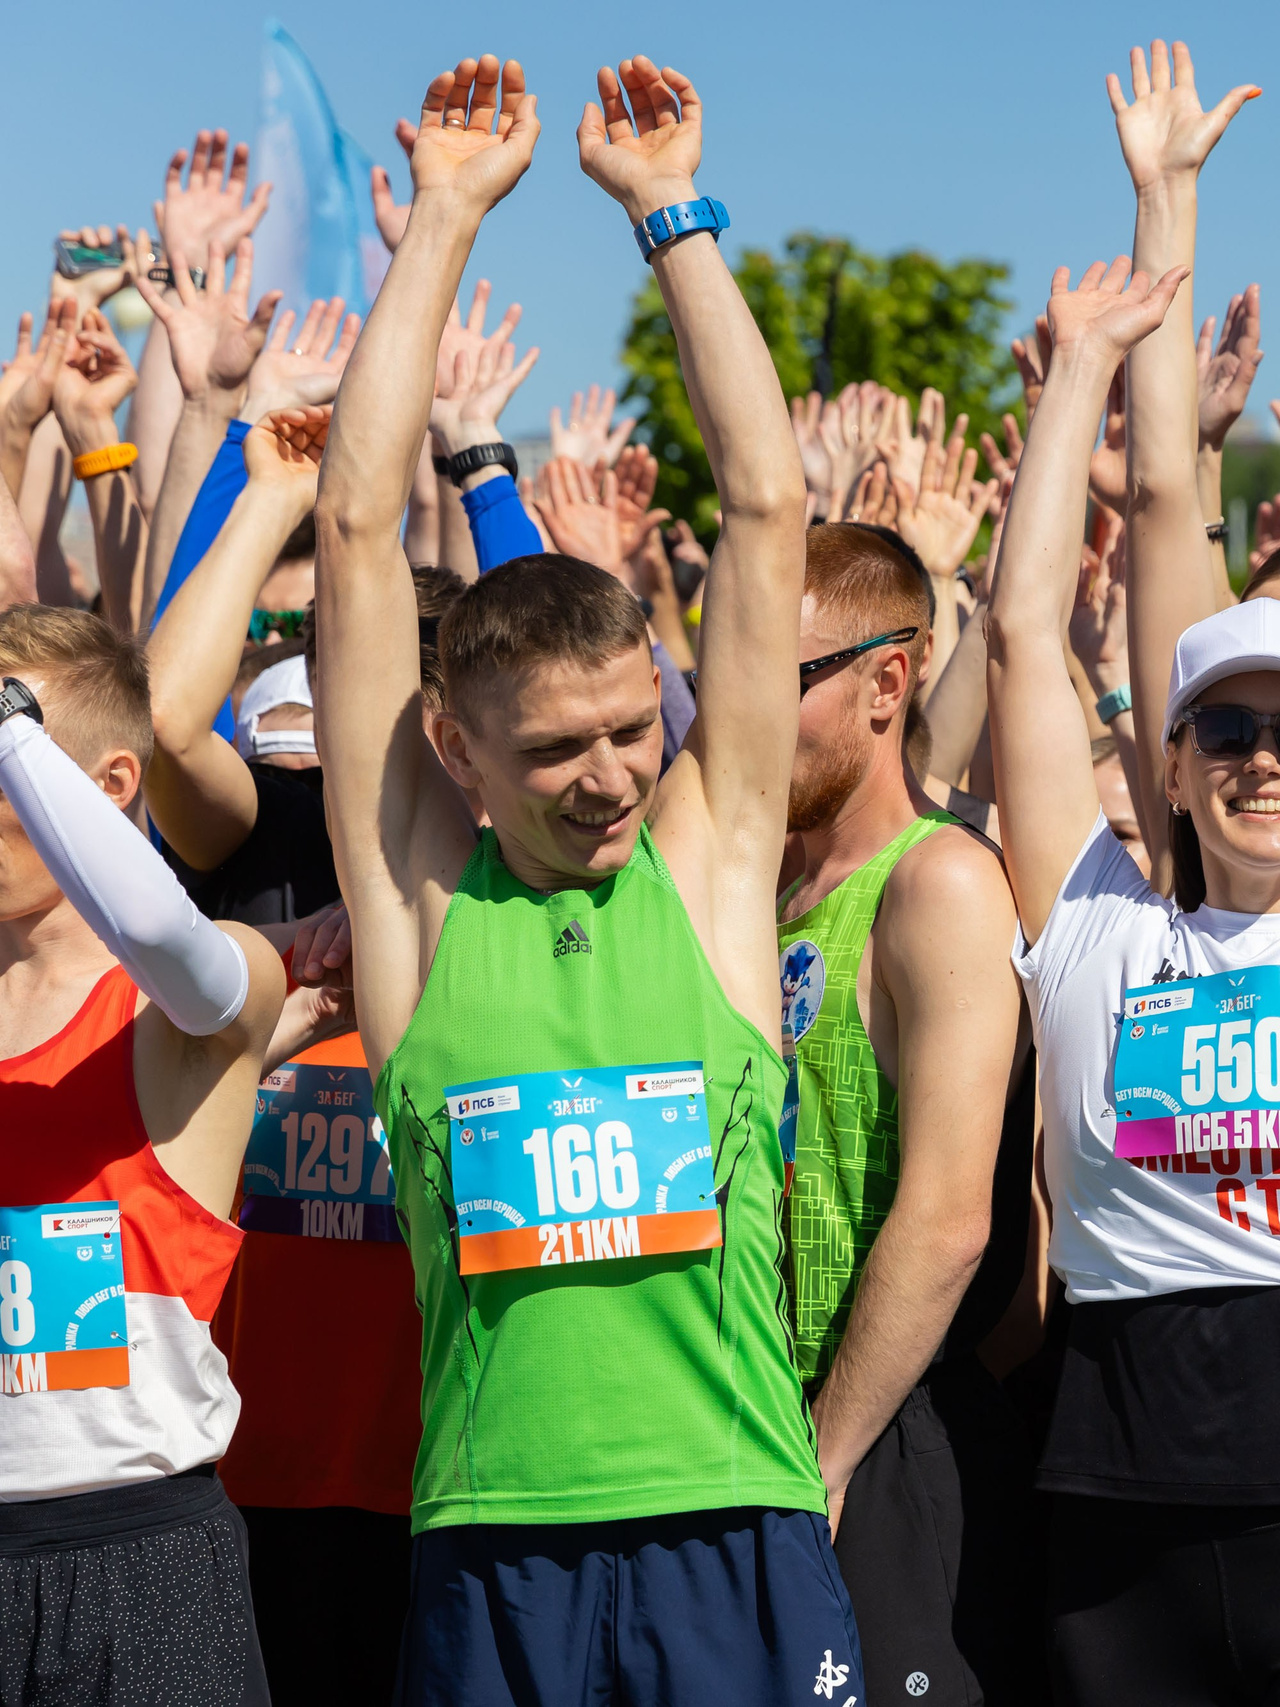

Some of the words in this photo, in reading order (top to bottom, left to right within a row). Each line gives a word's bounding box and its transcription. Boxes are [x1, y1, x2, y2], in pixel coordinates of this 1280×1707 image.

[553, 940, 592, 958] adida
[1148, 998, 1171, 1010] ПСБ
[268, 1076, 281, 1086] ПСБ
[651, 1077, 697, 1085] КАЛАШНИКОВ
[473, 1097, 495, 1110] ПСБ
[1115, 1088, 1132, 1102] БЕГУ
[1133, 1087, 1152, 1098] ВСЕМ
[1152, 1087, 1182, 1115] СЕРДЦЕМ
[1175, 1111, 1228, 1154] ПСБ
[1234, 1110, 1252, 1149] 5
[281, 1112, 390, 1195] 1297
[682, 1149, 696, 1165] БЕГ
[696, 1147, 704, 1159] В
[523, 1120, 640, 1216] 166
[456, 1200, 473, 1215] БЕГУ
[474, 1199, 492, 1211] ВСЕМ
[493, 1200, 526, 1228] СЕРДЦЕМ
[1216, 1178, 1250, 1232] С
[67, 1216, 113, 1224] КАЛАШНИКОВ
[0, 1260, 35, 1347] 8
[75, 1299, 98, 1319] ЛЮБИ
[95, 1288, 110, 1303] БЕГ
[110, 1286, 117, 1298] В
[117, 1284, 125, 1296] С
